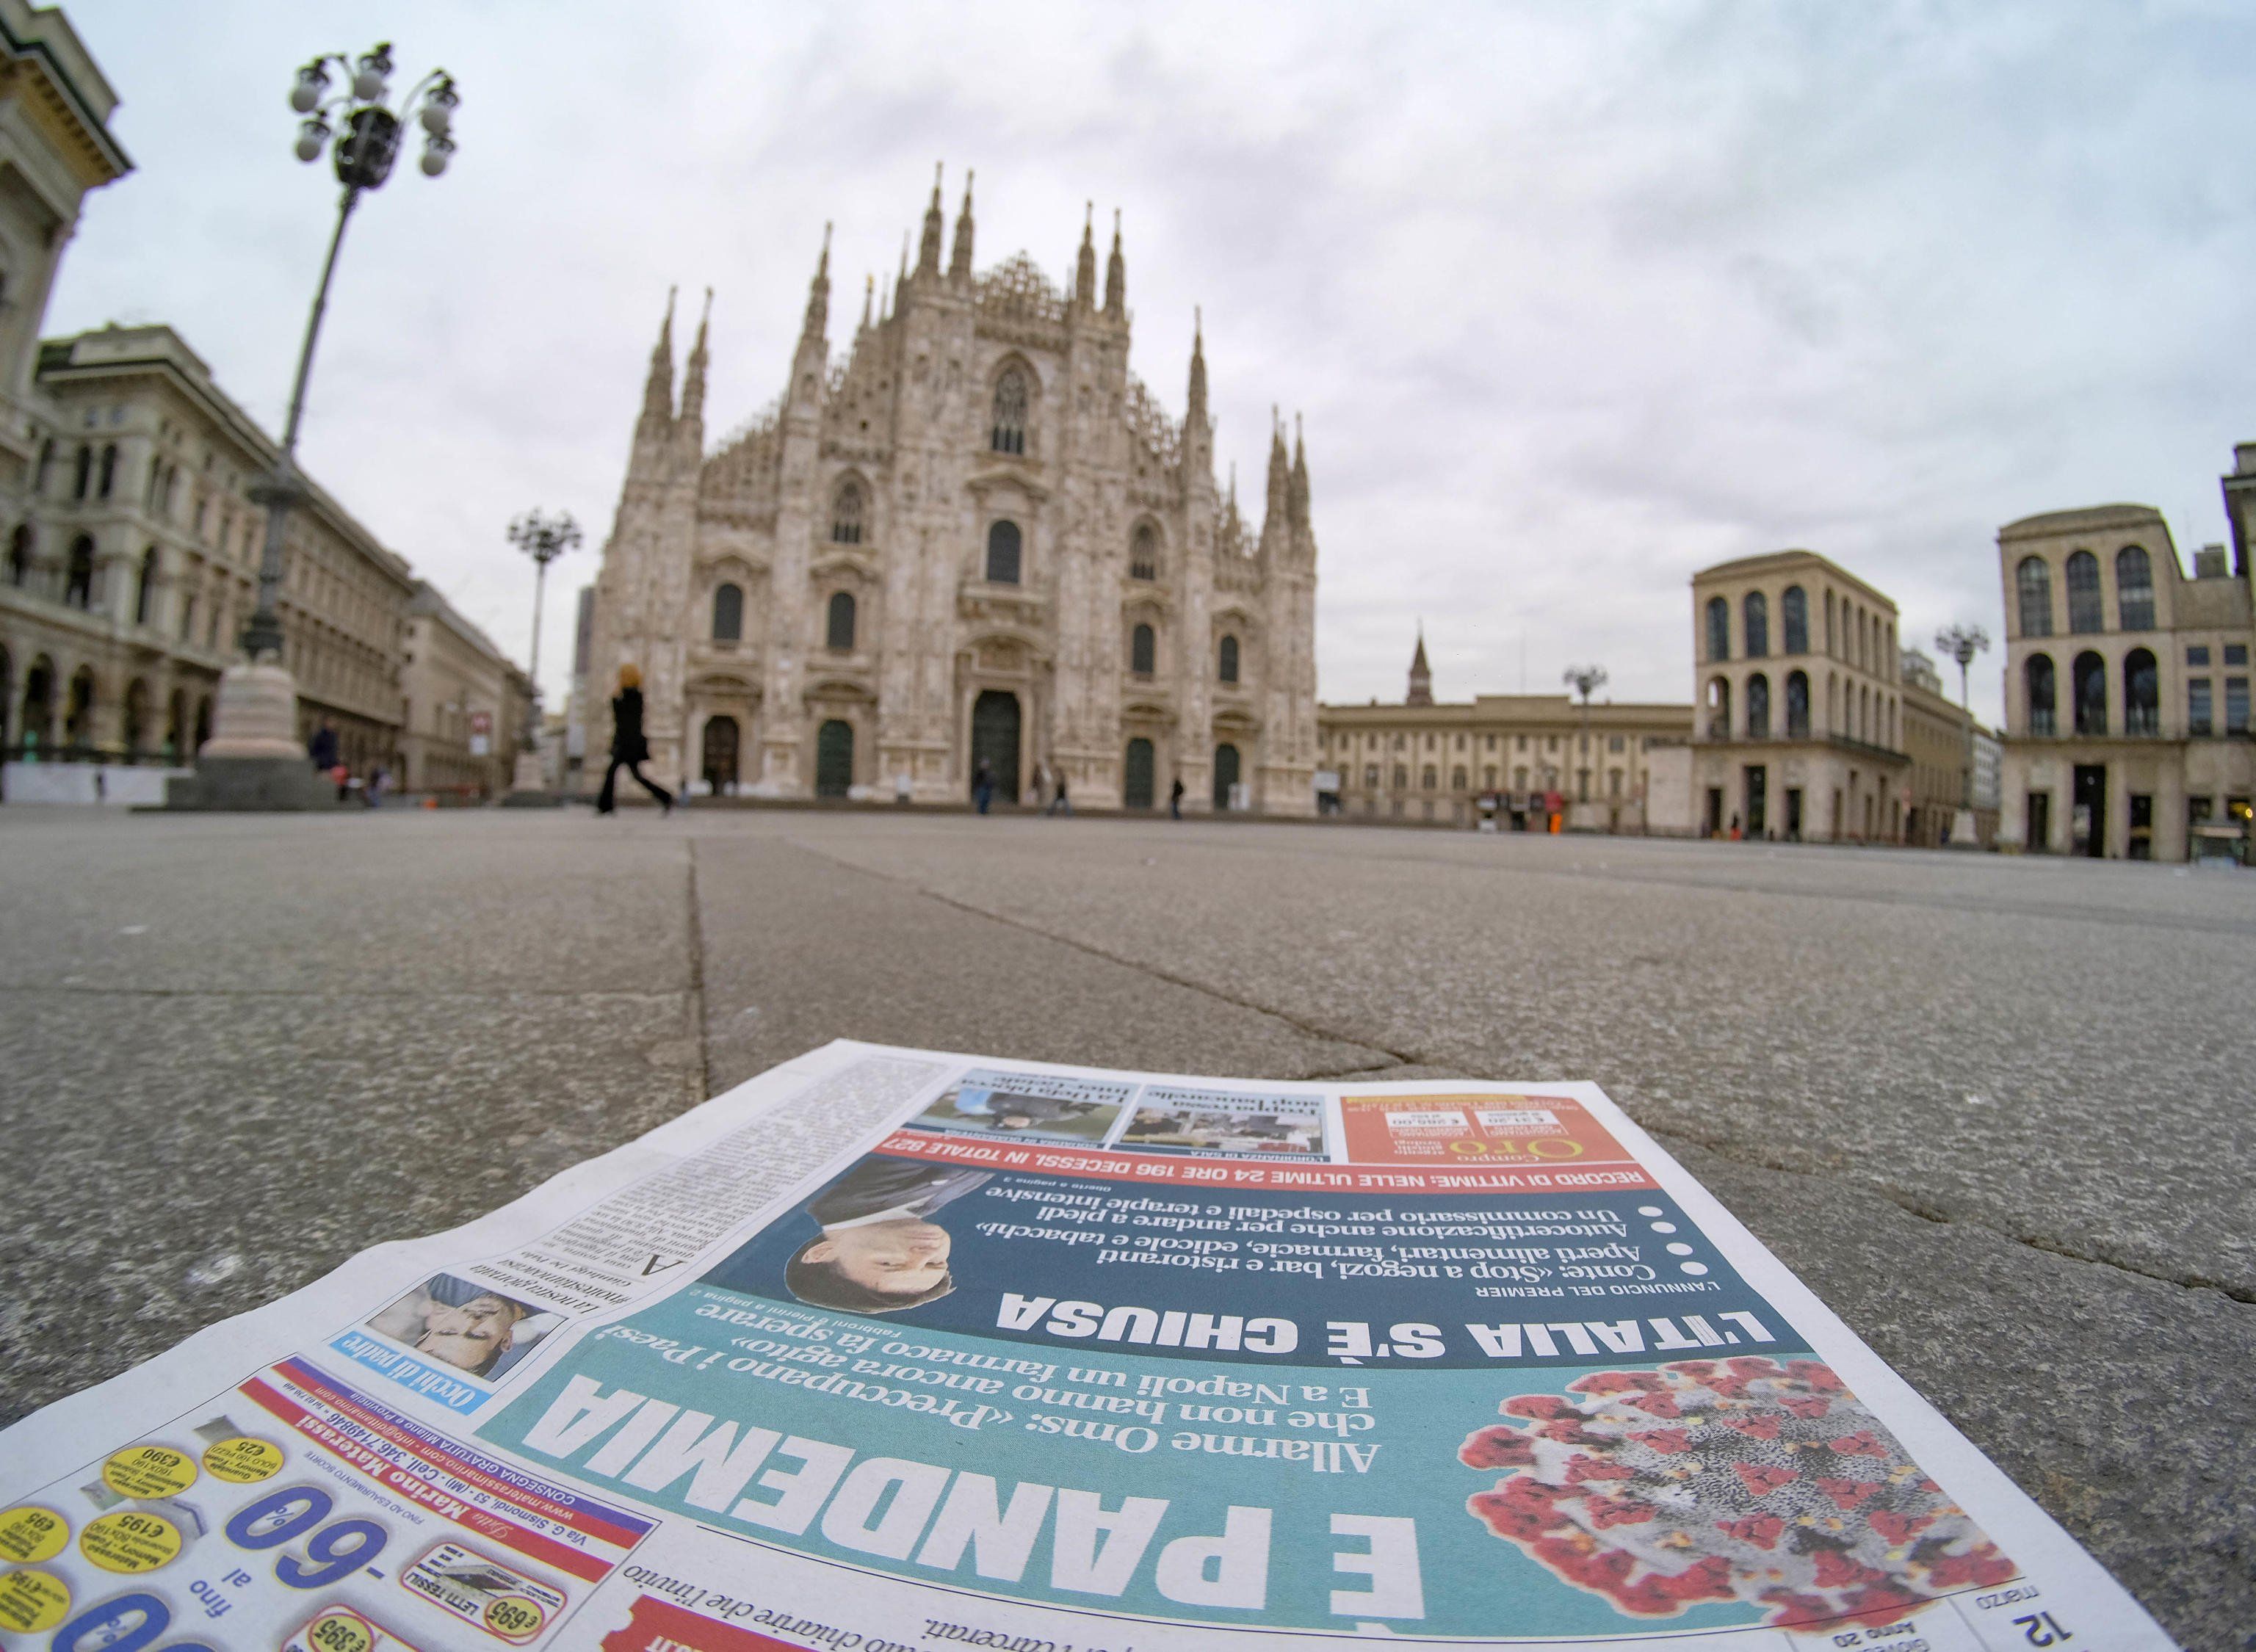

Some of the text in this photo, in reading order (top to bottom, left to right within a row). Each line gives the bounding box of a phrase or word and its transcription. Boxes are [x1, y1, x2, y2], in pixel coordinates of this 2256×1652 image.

[881, 1137, 1646, 1188] RECORD DI VITTIME: NELLE ULTIME 24 ORE 196 DECESSI. IN TOTALE 827
[1449, 1138, 1583, 1159] Oro
[1456, 1153, 1539, 1163] Compro
[1016, 1177, 1056, 1187] pagina
[986, 1186, 1622, 1225] Un commissario per ospedali e terapie intensive
[1036, 1206, 1627, 1240] Autocertificazione anche per andare a piedi
[975, 1221, 1640, 1264] Aperti alimentari, farmacie, edicole e tabacchi»
[641, 1255, 688, 1276] A
[1096, 1248, 1656, 1283] Conte: «Stop a negozi, bar e ristoranti
[705, 1290, 755, 1309] pagina
[1475, 1281, 1721, 1297] L'ANNUNCIO DEL PREMIER
[573, 1300, 599, 1314] La
[754, 1303, 767, 1312] a
[832, 1319, 902, 1338] Fabbroni
[996, 1292, 1776, 1364] L'ITALIA S'È CHIUSA
[593, 1325, 706, 1364] Paesi
[694, 1303, 1373, 1408] E a Napoli un farmaco fa sperare
[340, 1336, 475, 1408] Occhi di padre
[695, 1350, 728, 1370] i
[730, 1336, 1375, 1436] che non hanno ancora agito»
[349, 1391, 396, 1419] Provincia
[403, 1420, 440, 1444] Milano
[1024, 1413, 1160, 1453] Oms:
[141, 1448, 181, 1468] €390
[234, 1441, 266, 1456] €25
[440, 1441, 499, 1477] GRATUITA
[1171, 1431, 1382, 1473] Allarme
[294, 1414, 514, 1539] Ditta Marino Materassi
[408, 1457, 440, 1480] Cell.
[304, 1451, 424, 1525] FINO AD ESAURIMENTO SCORTE
[419, 1446, 574, 1520] www.materassimarino.com
[445, 1477, 470, 1494] (MI)
[501, 1469, 576, 1505] CONSEGNA
[474, 1491, 491, 1504] 53
[520, 1373, 1425, 1634] È PANDEMIA
[25, 1512, 55, 1532] €95
[117, 1515, 164, 1537] €195
[494, 1498, 550, 1529] Sismondi,
[552, 1524, 565, 1537] G.
[568, 1529, 588, 1546] Via
[221, 1568, 252, 1587] al
[621, 1566, 707, 1607] l'invito
[189, 1580, 232, 1619] fino
[405, 1571, 480, 1615] LETTI TESSILI
[1975, 1585, 2040, 1609] marzo
[704, 1595, 754, 1620] che
[753, 1610, 862, 1652] chiarire
[1832, 1632, 1862, 1648] 20
[2011, 1611, 2073, 1648] 12
